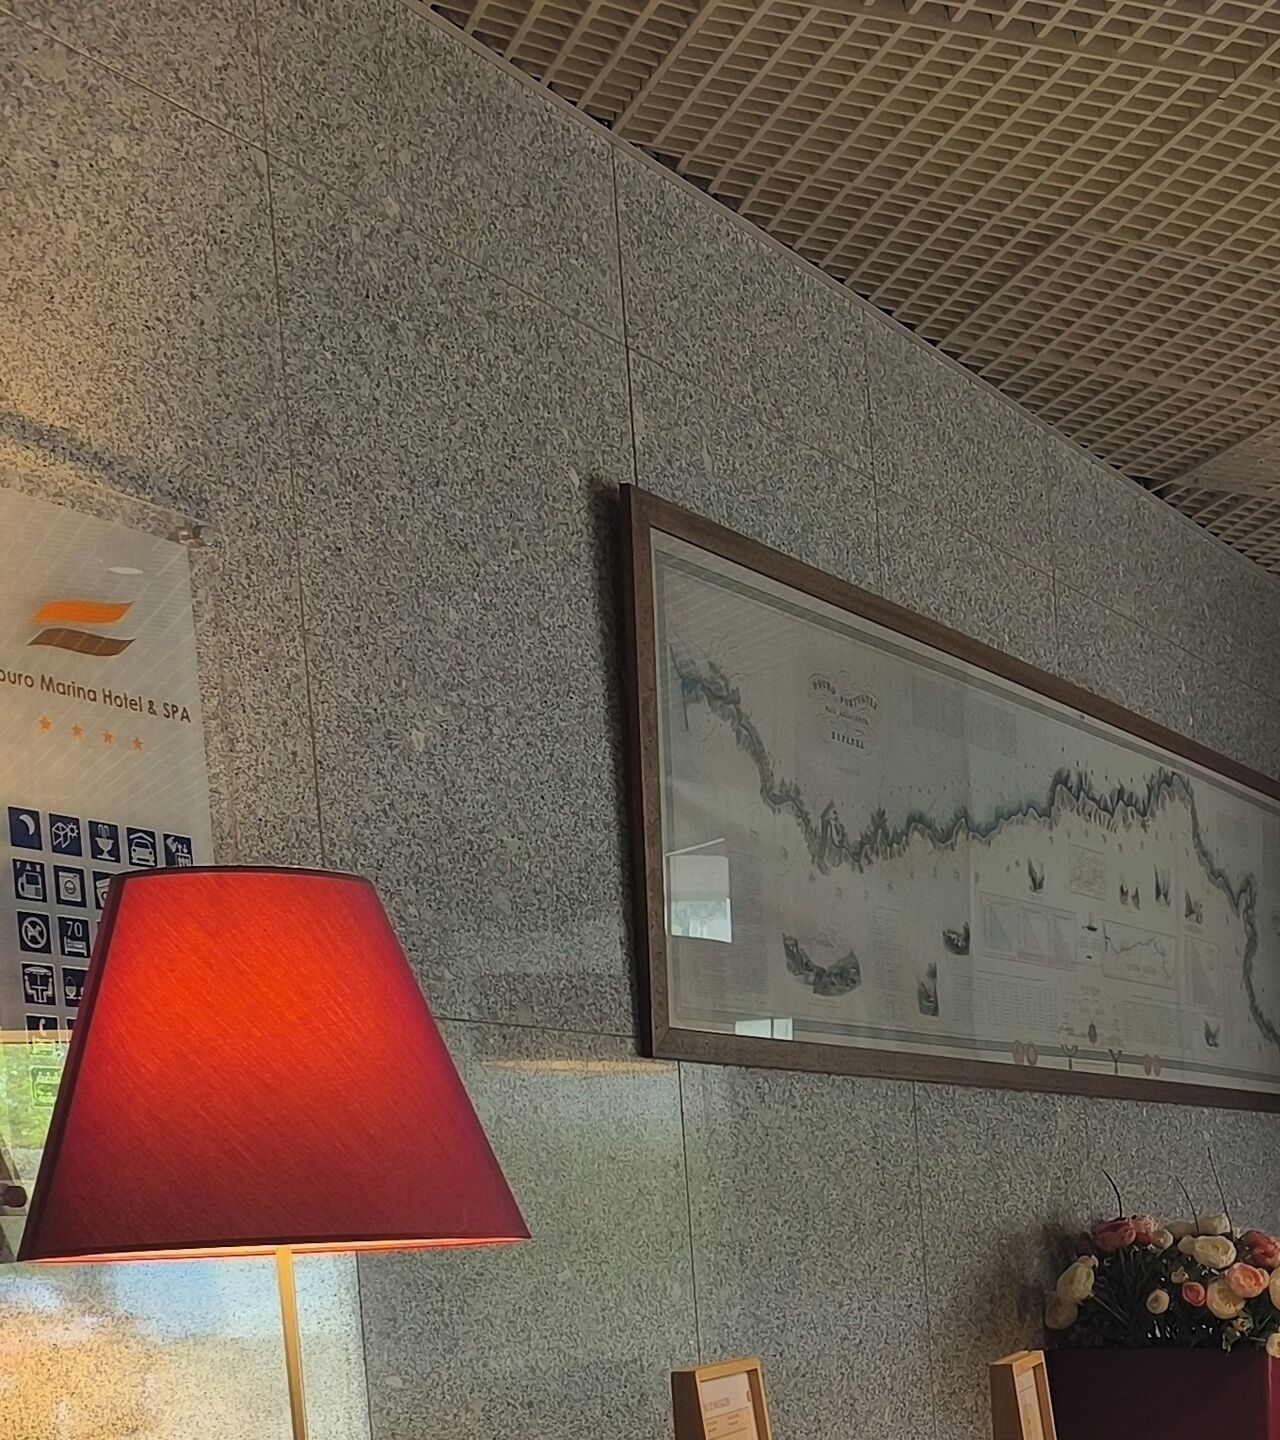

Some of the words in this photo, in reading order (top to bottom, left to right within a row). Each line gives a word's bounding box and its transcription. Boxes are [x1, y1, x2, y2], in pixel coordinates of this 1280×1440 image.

[40, 674, 97, 703] Marina
[102, 688, 143, 713] Hotel
[147, 699, 158, 717] &
[163, 702, 192, 724] SPA
[15, 861, 41, 873] FAX
[65, 920, 83, 938] 70
